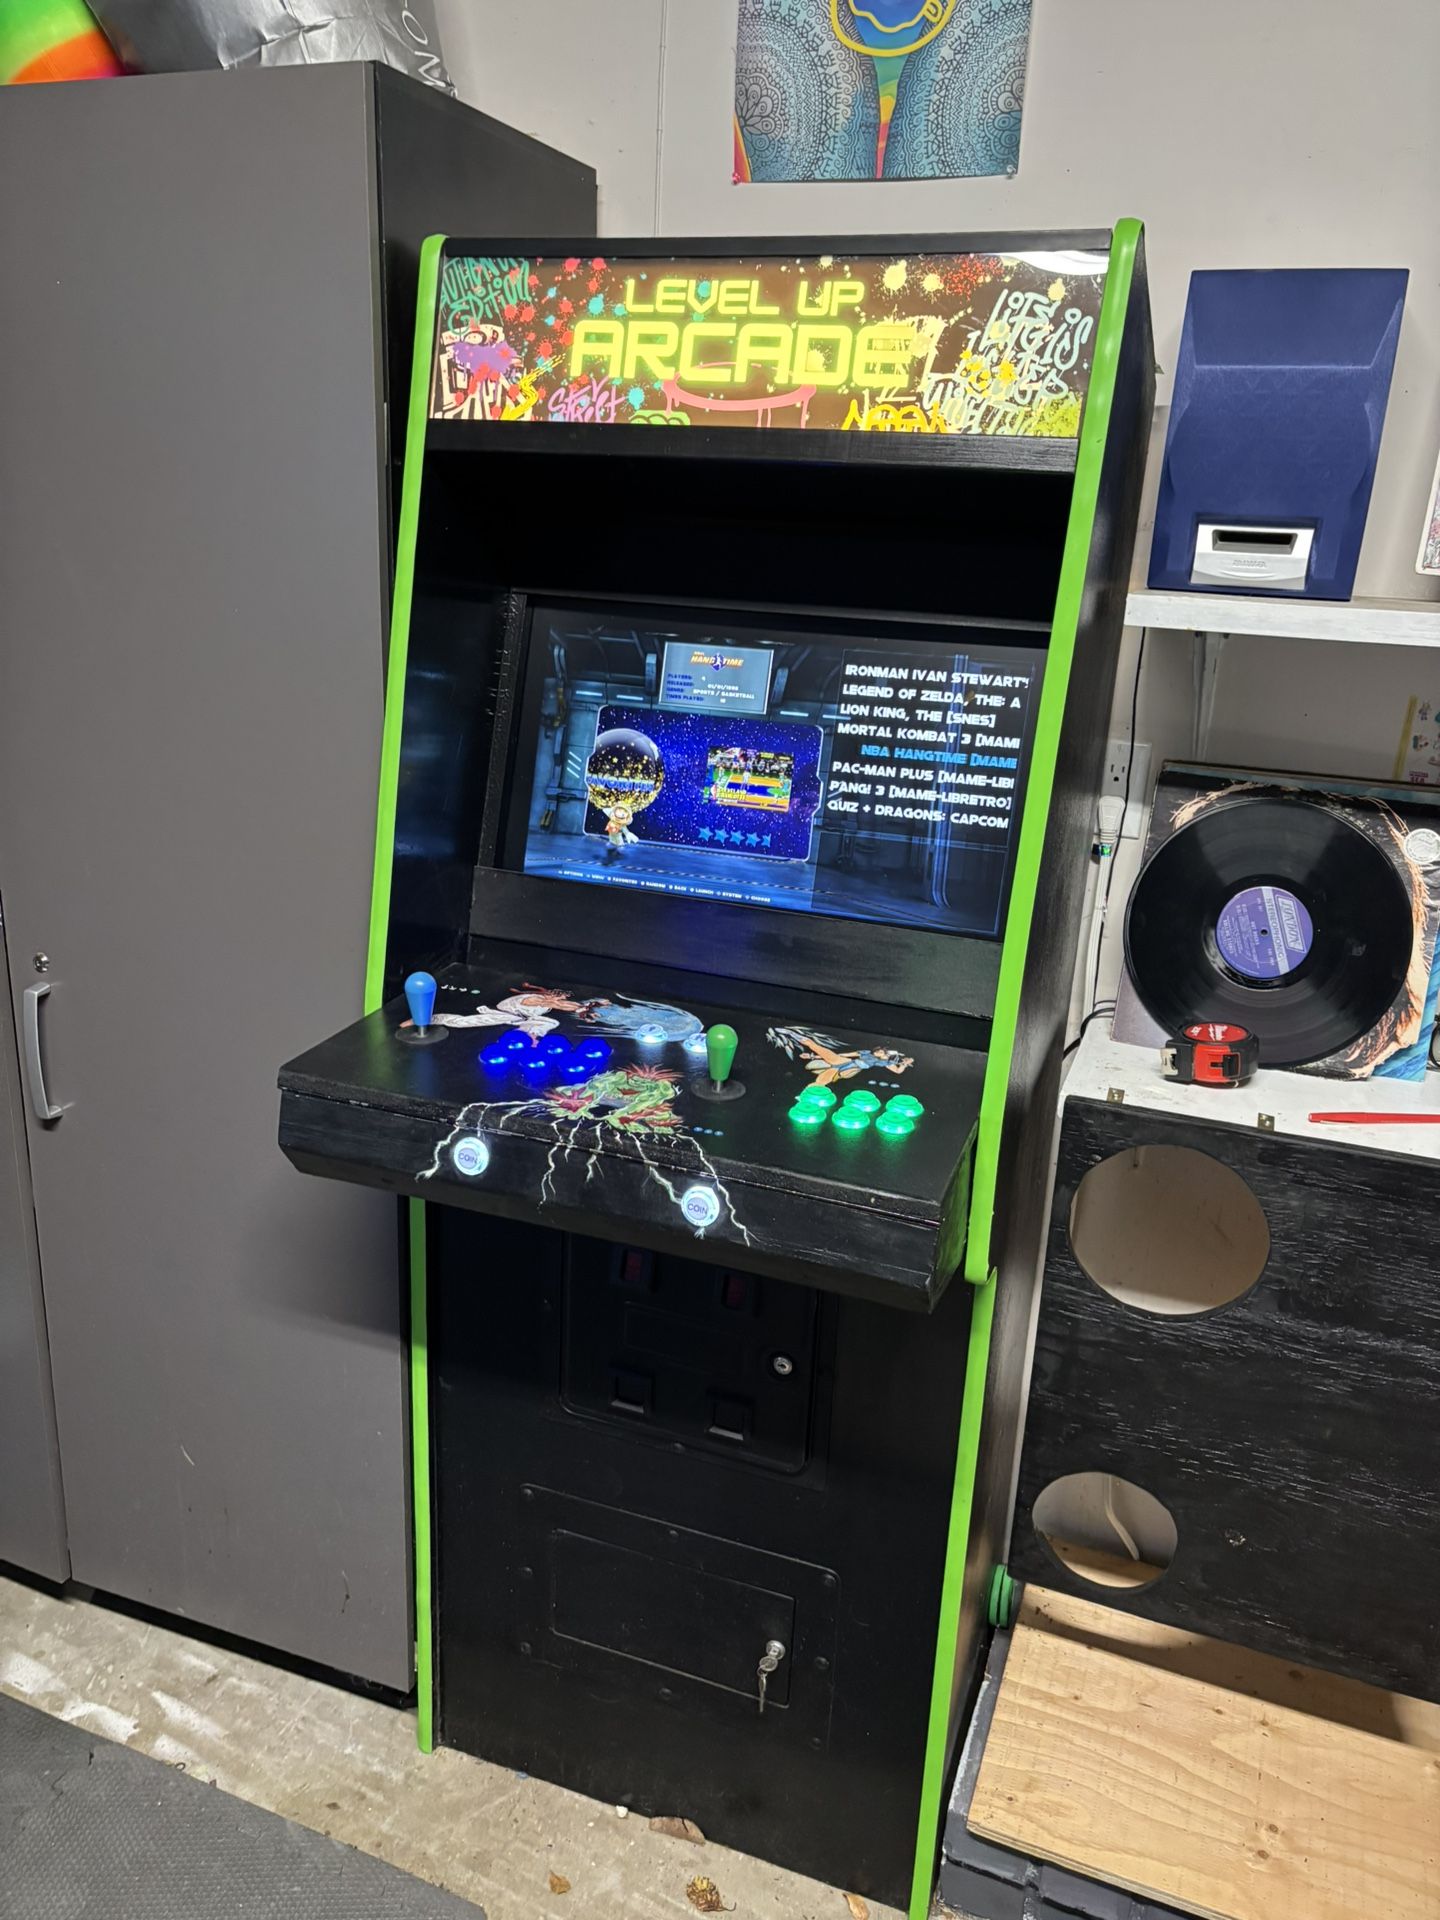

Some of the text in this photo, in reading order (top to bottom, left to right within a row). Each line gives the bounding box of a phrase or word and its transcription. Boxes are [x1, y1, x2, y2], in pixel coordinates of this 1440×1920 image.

[625, 279, 865, 316] LEVEL UP
[569, 320, 916, 388] ARCADE
[845, 664, 909, 679] IRONMAN
[912, 669, 947, 682] IVAN
[843, 684, 1021, 708] LEGEND OF ZELDA, THE: A
[840, 703, 996, 728] LION KING, THE [SNES]
[837, 722, 1020, 749] MORTAL KOMBAT 3 [MAM
[861, 744, 890, 757] NBA
[894, 747, 967, 764] HANGTIME
[832, 761, 1014, 789] PAC-MAN PLUS [MAME-LIB
[829, 780, 1012, 810] PANG! 3 [MAME-LIBRETRO]
[827, 799, 1008, 829] QUIZ + DRAGONS: CAPCOM
[688, 1203, 708, 1215] COIN
